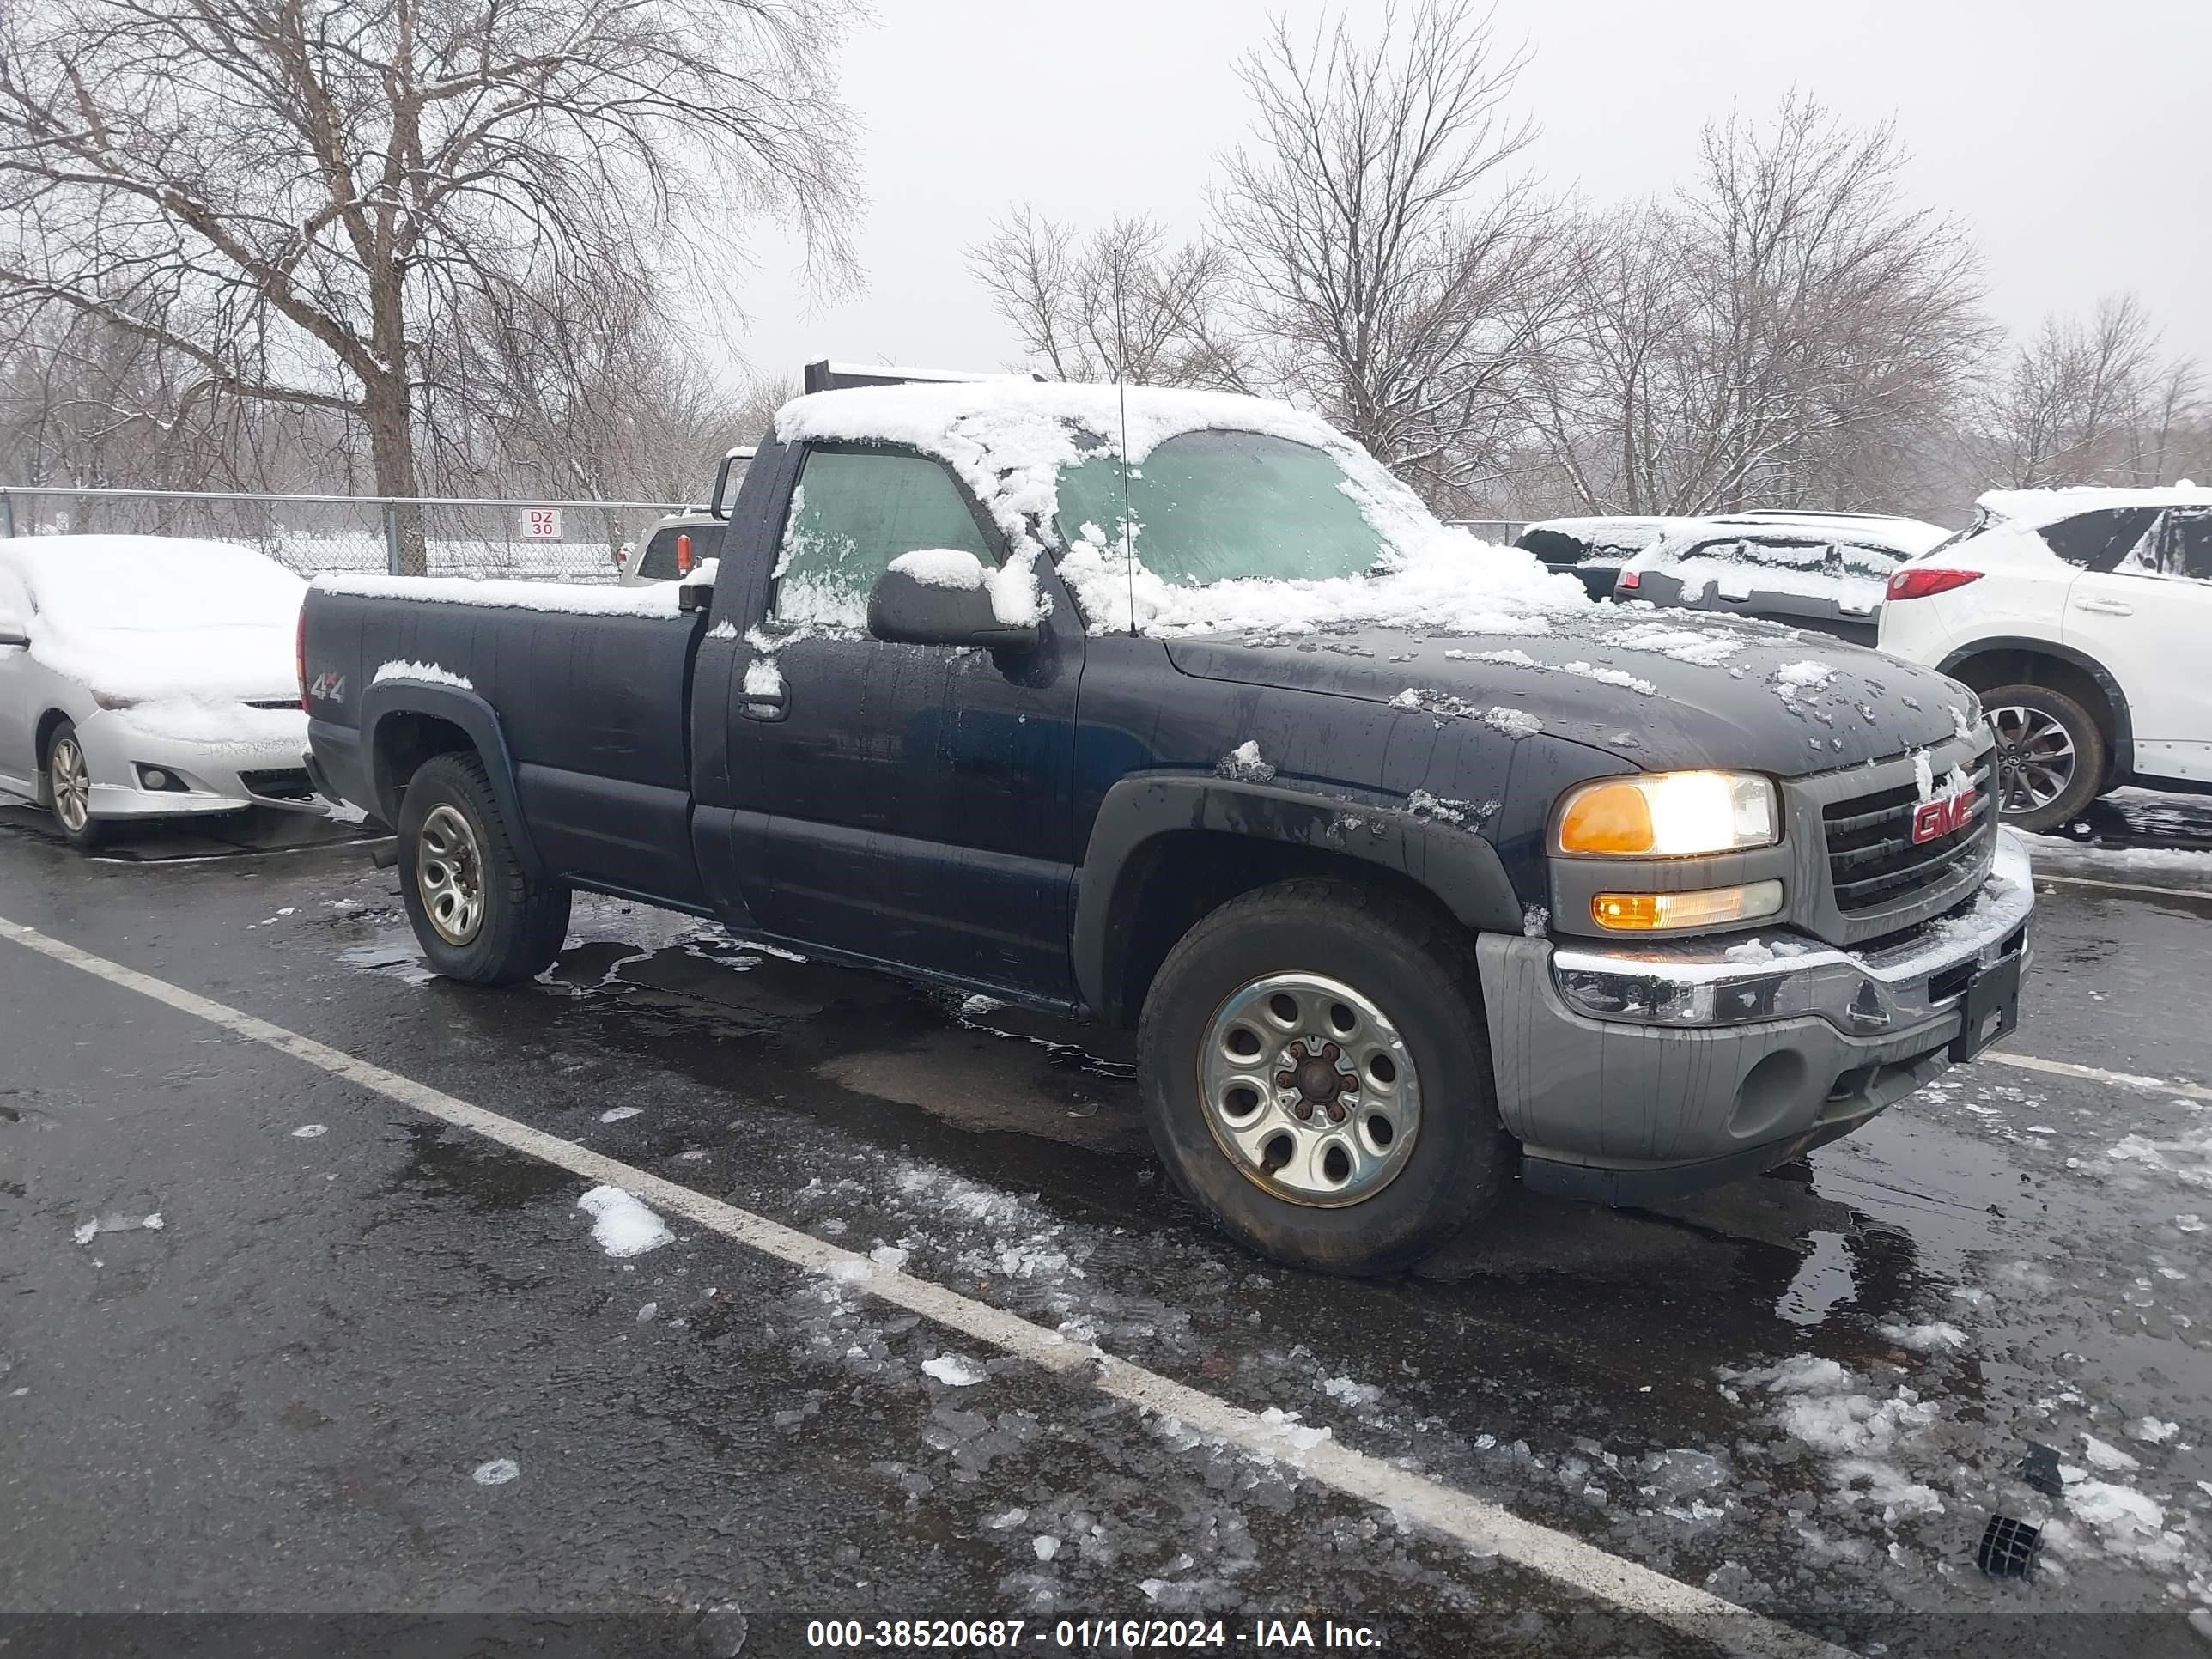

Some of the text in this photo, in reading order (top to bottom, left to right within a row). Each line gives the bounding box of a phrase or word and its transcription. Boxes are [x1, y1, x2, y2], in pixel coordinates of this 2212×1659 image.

[531, 512, 553, 523] DZ
[532, 524, 553, 535] 30
[1912, 787, 1977, 845] GMC
